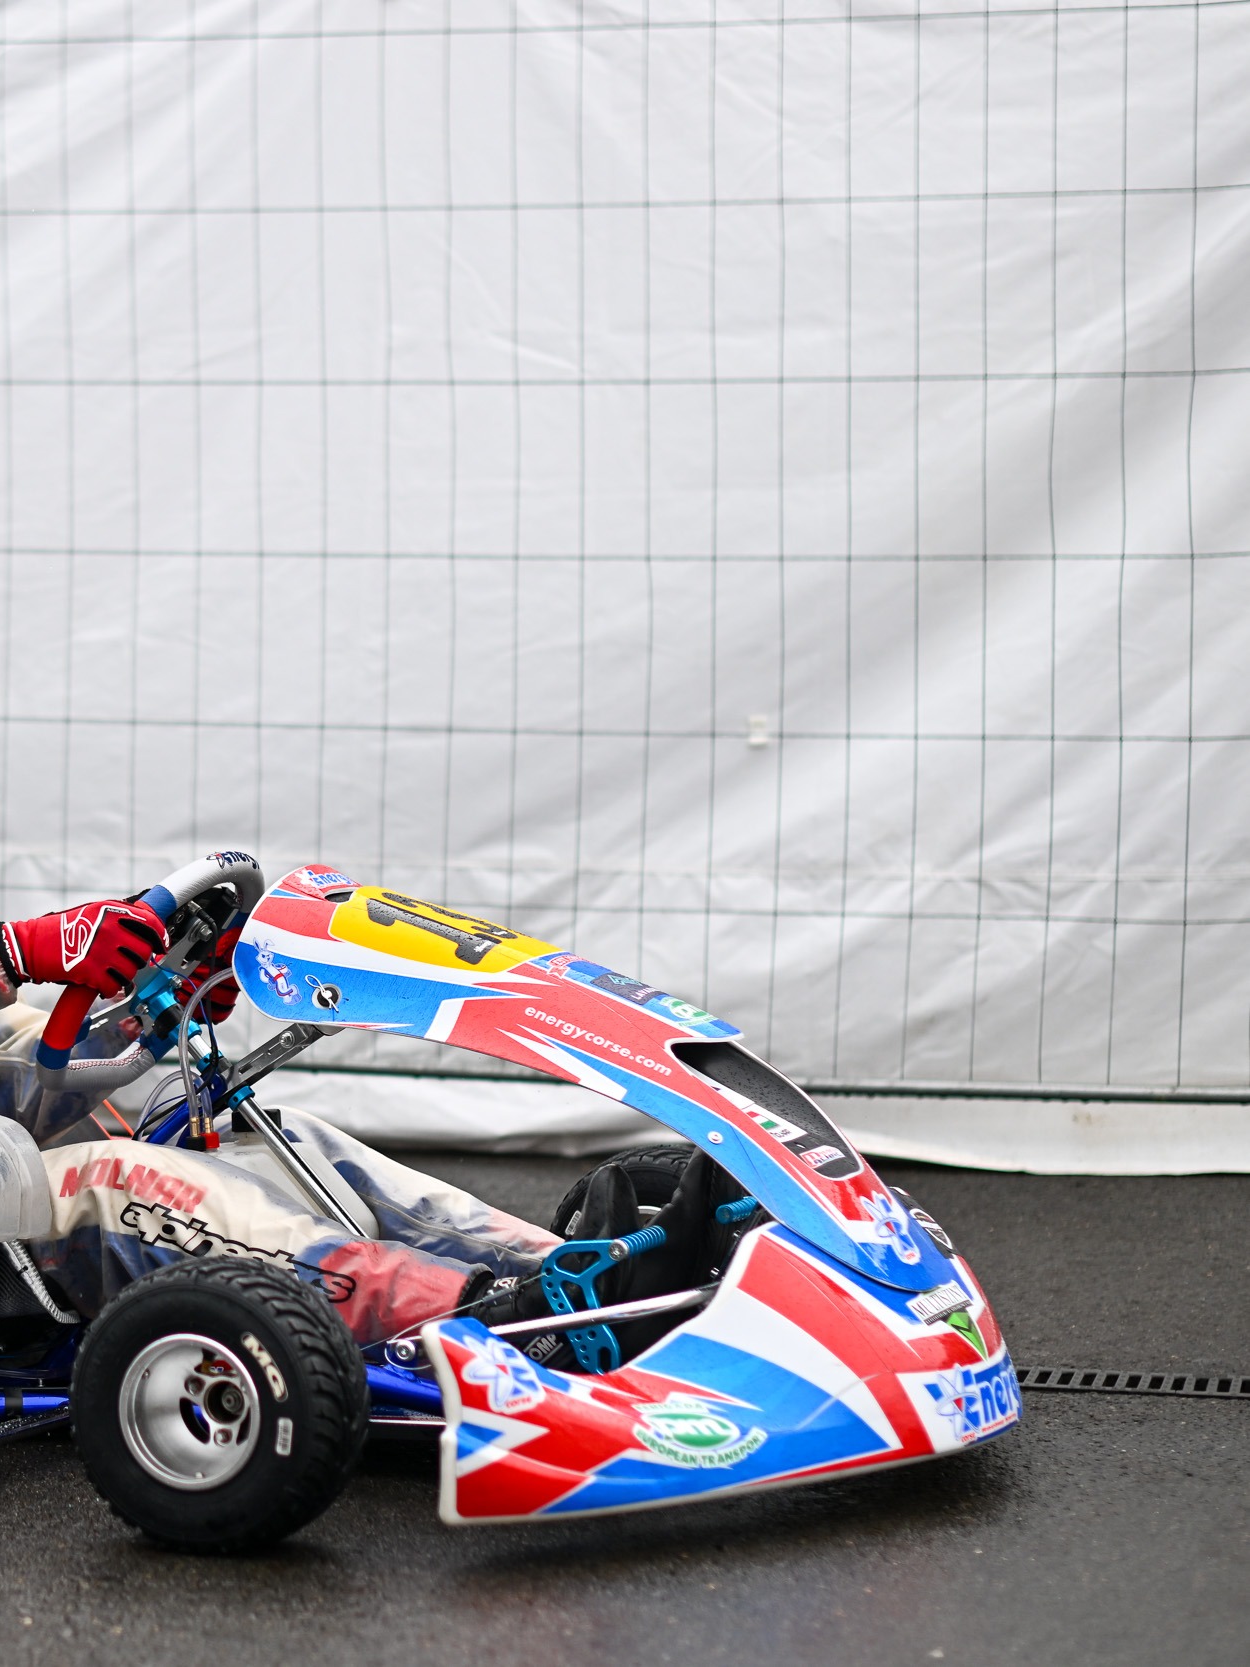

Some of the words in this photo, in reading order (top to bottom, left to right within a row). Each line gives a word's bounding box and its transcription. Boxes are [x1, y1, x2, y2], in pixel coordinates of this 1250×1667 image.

[524, 1006, 672, 1077] energycorse.com
[244, 1335, 286, 1399] MG
[528, 1333, 557, 1361] OMP
[636, 1428, 699, 1466] EUROPEAN
